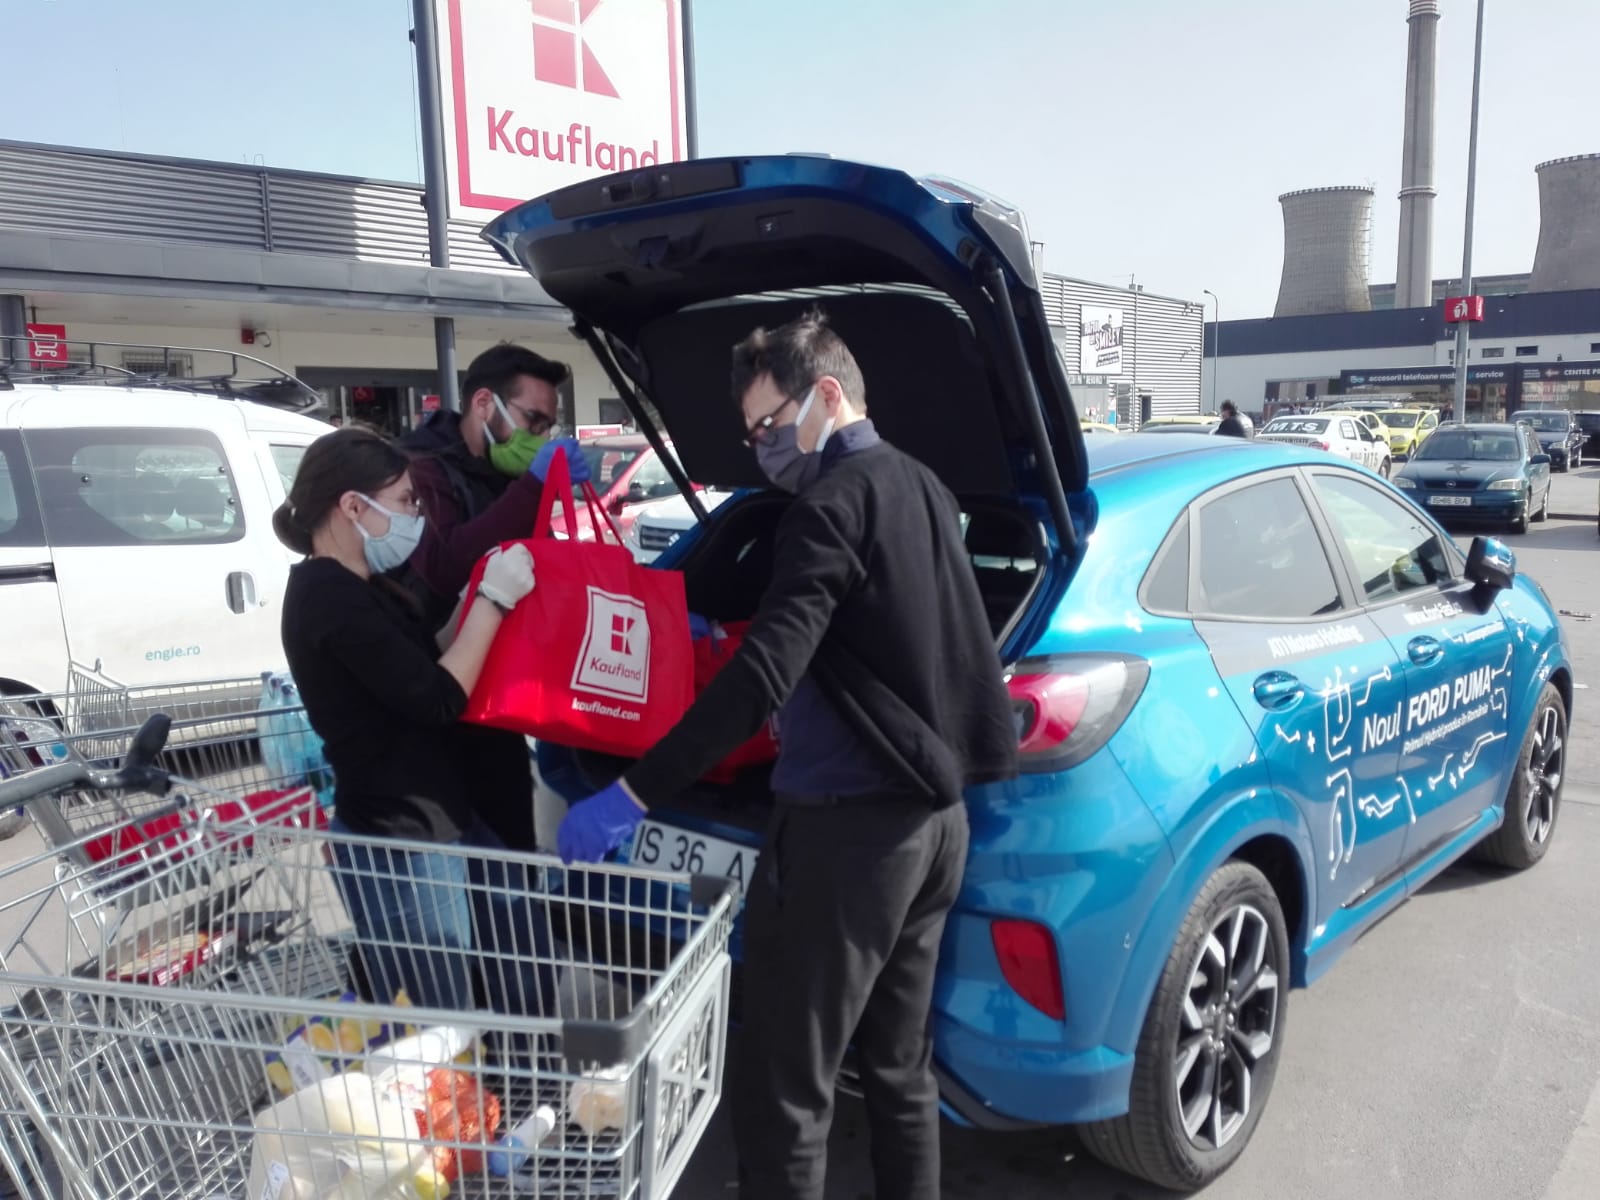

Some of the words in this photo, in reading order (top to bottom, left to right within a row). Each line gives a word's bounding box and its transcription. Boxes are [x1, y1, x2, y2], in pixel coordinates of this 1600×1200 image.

[487, 106, 658, 172] Kaufland
[1402, 373, 1439, 381] telefoane
[1476, 371, 1504, 379] service
[145, 645, 201, 661] engie.ro
[590, 657, 642, 681] Kaufland
[571, 697, 641, 721] kaufland.com
[1362, 701, 1402, 753] Noul
[1406, 684, 1450, 732] FORD
[1453, 665, 1491, 710] PUMA
[634, 824, 664, 864] IS
[670, 834, 707, 874] 36
